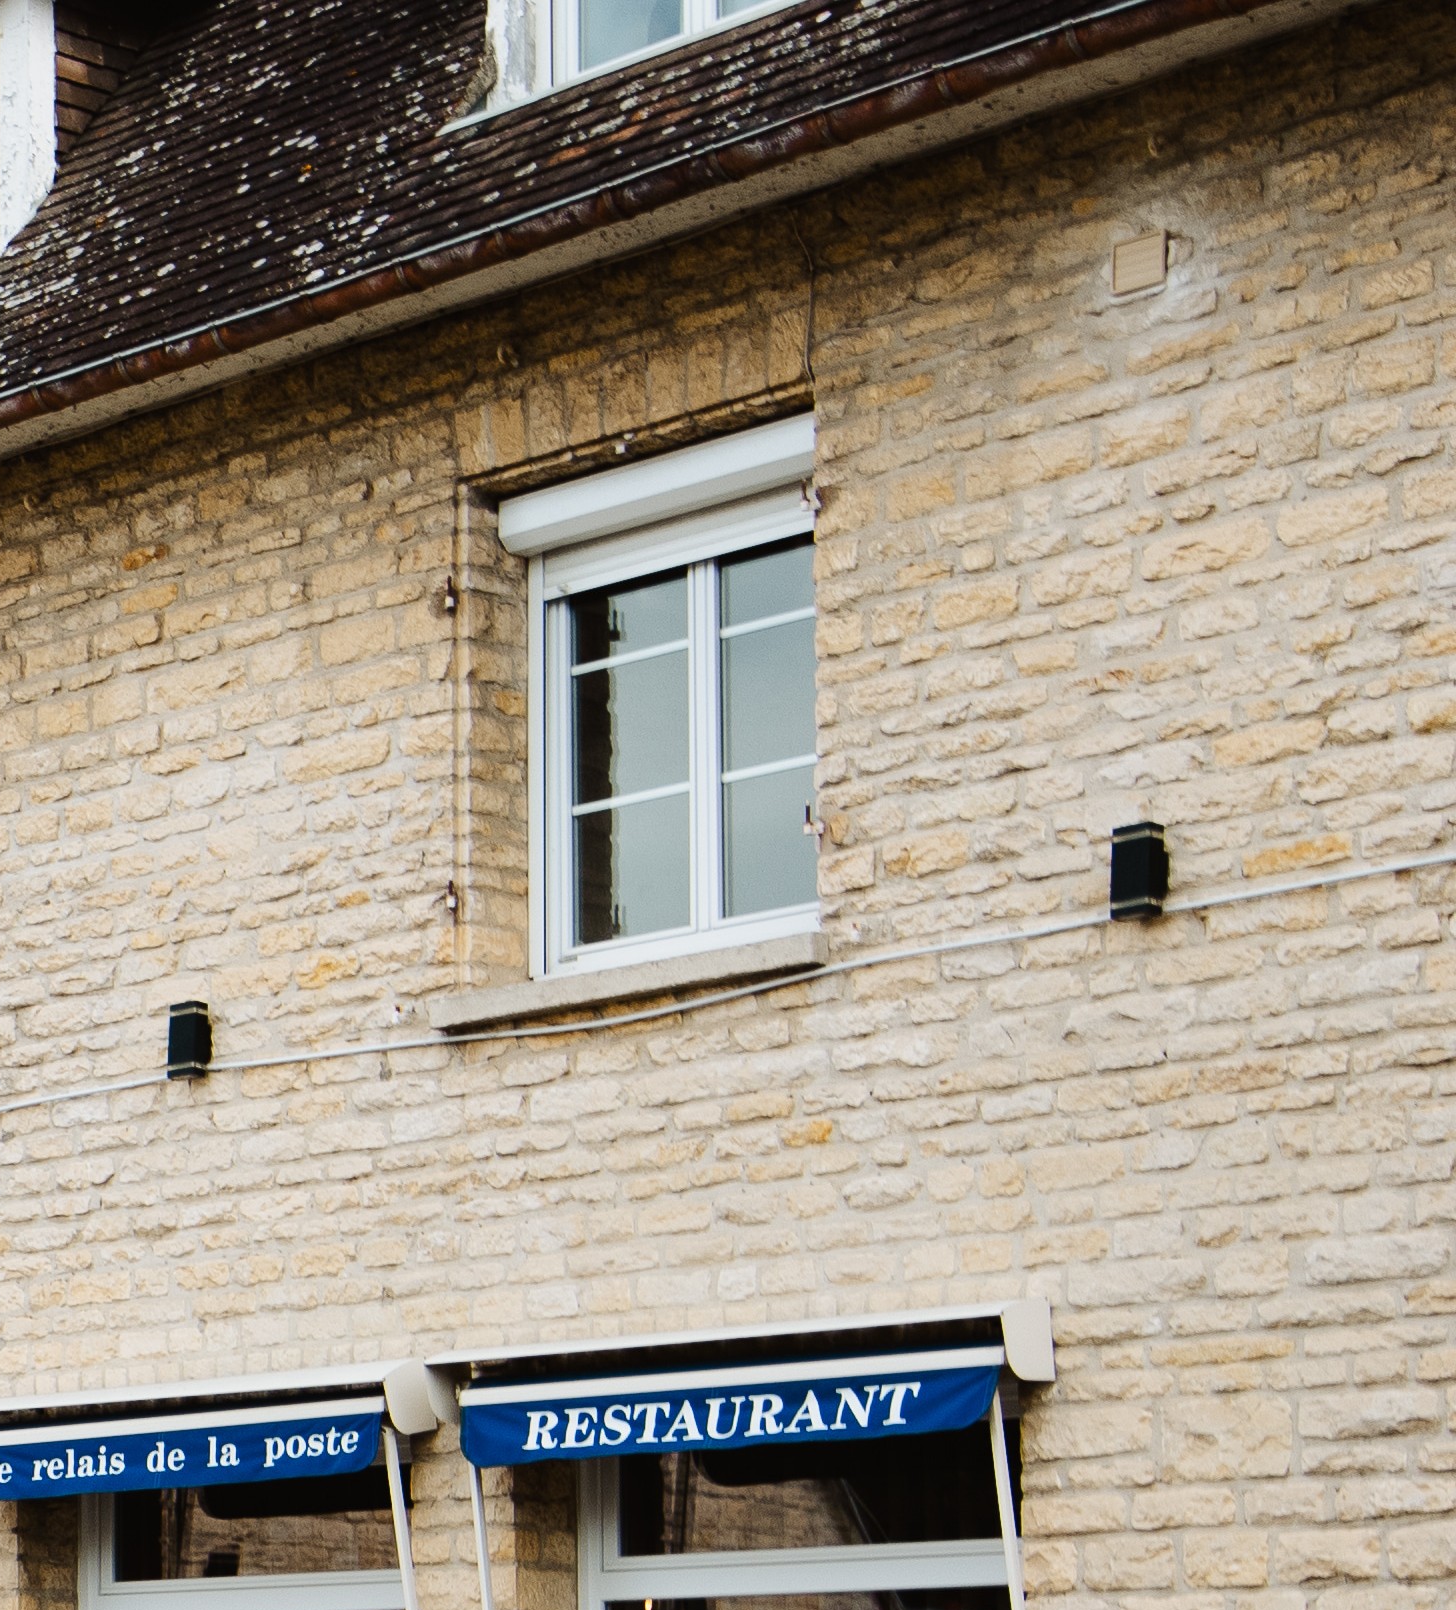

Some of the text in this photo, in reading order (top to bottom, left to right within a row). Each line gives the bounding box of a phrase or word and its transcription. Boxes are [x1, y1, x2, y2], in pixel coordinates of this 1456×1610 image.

[521, 1381, 922, 1452] RESTAURANT
[31, 1445, 126, 1483] relais
[146, 1441, 186, 1473] de
[207, 1436, 240, 1468] la
[263, 1426, 360, 1469] poste
